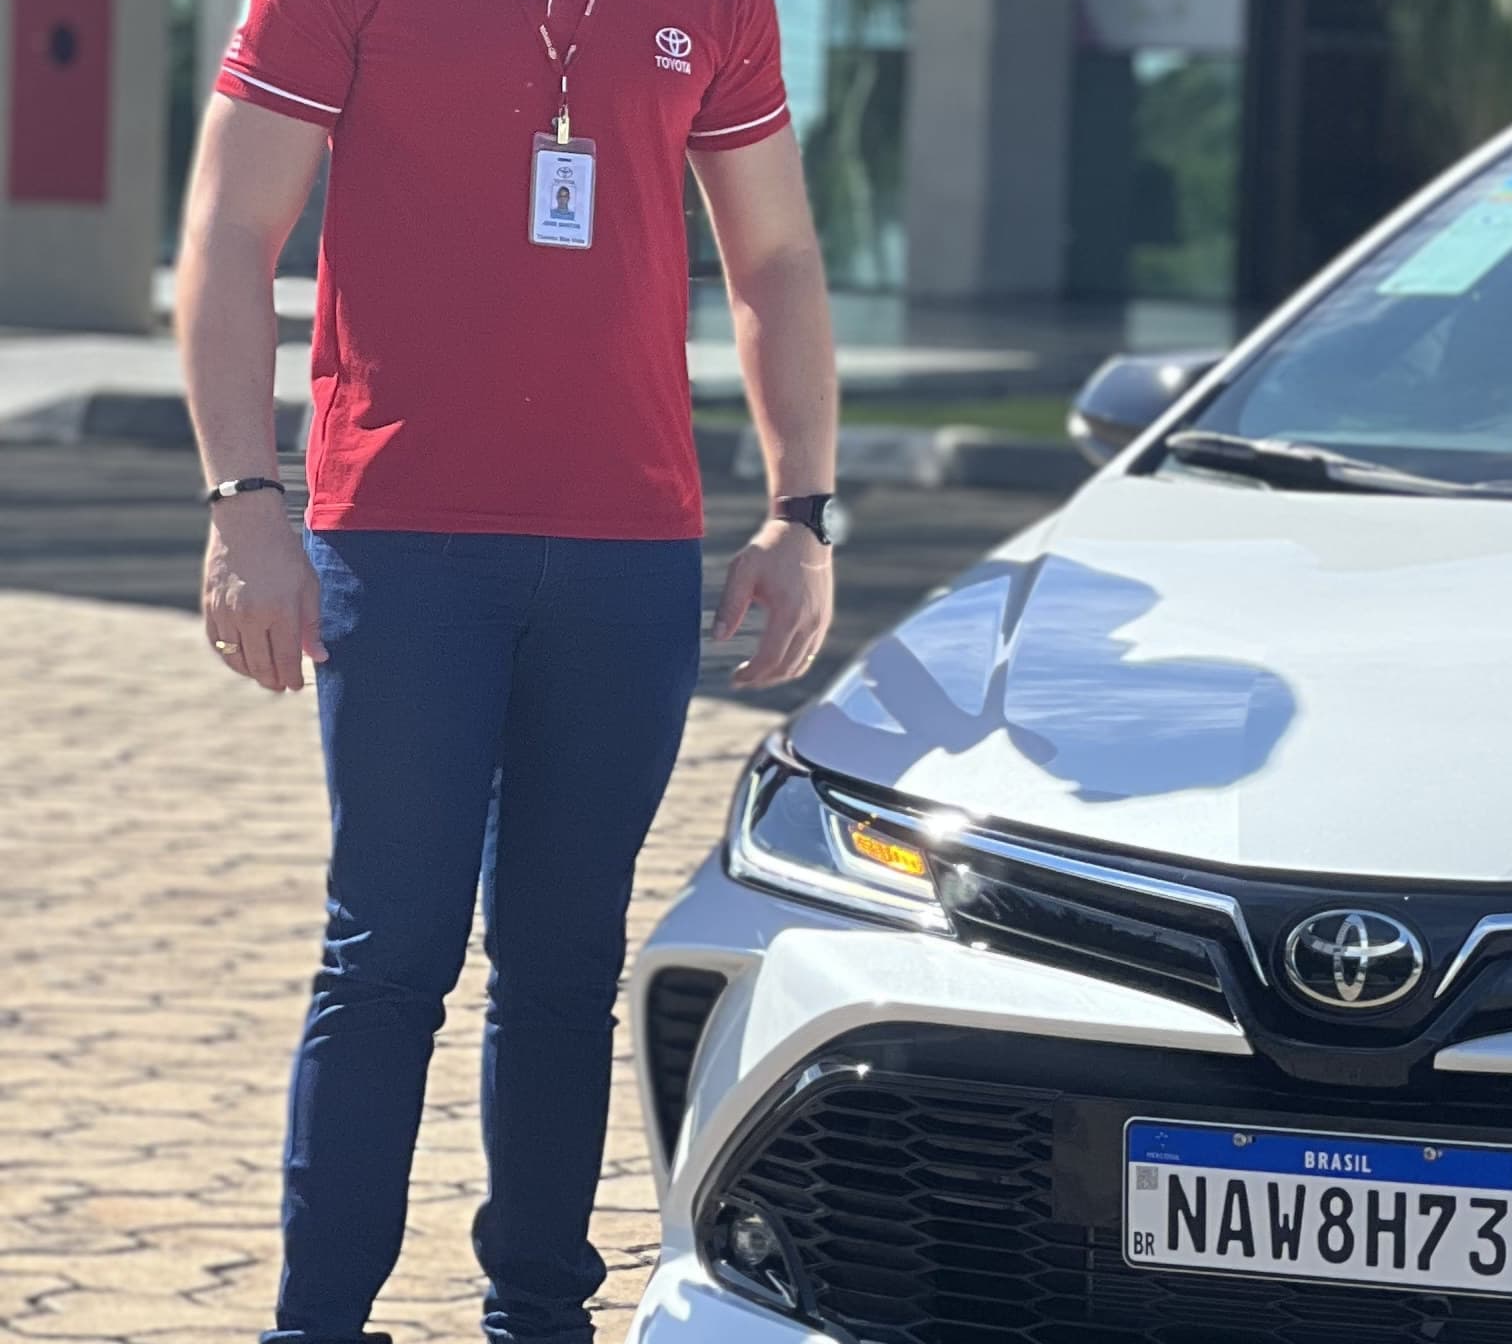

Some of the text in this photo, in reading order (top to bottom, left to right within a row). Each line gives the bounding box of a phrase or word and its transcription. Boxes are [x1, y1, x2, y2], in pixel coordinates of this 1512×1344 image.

[654, 55, 691, 75] TOYOTA
[1304, 1151, 1372, 1173] BRASIL
[1167, 1173, 1509, 1277] NAW8H73
[1133, 1231, 1156, 1256] BR
